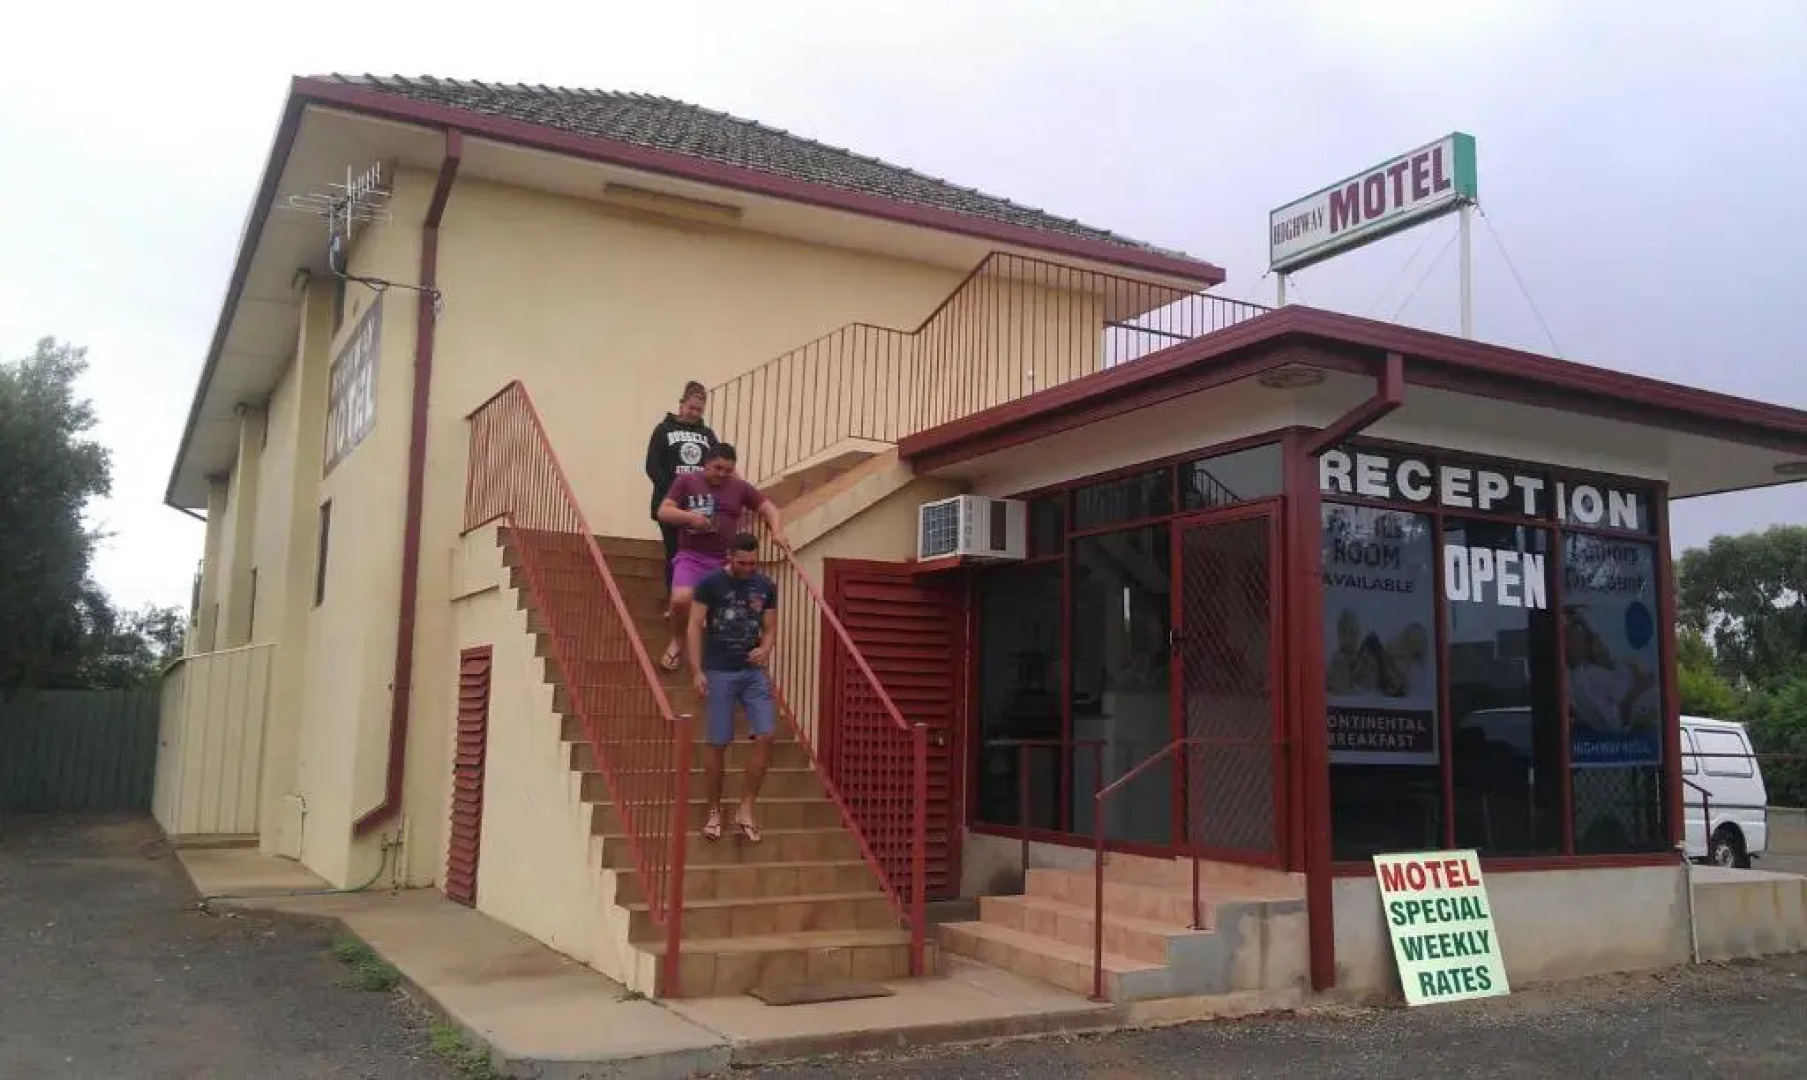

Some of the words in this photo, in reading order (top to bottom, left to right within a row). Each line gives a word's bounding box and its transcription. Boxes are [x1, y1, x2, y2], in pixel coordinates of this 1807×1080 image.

[1273, 205, 1324, 245] HIGHWAY
[1329, 146, 1451, 234] MOTEL
[1319, 450, 1639, 530] RECEPTION
[1334, 538, 1401, 571] ROOM
[1322, 571, 1414, 593] AVAILABLE
[1444, 544, 1547, 610] OPEN
[1327, 713, 1427, 733] ONTINENTAL
[1380, 859, 1480, 892] MOTEL
[1390, 896, 1488, 926] SPECIAL
[1399, 930, 1490, 961] WEEKLY
[1418, 965, 1492, 997] RATES
